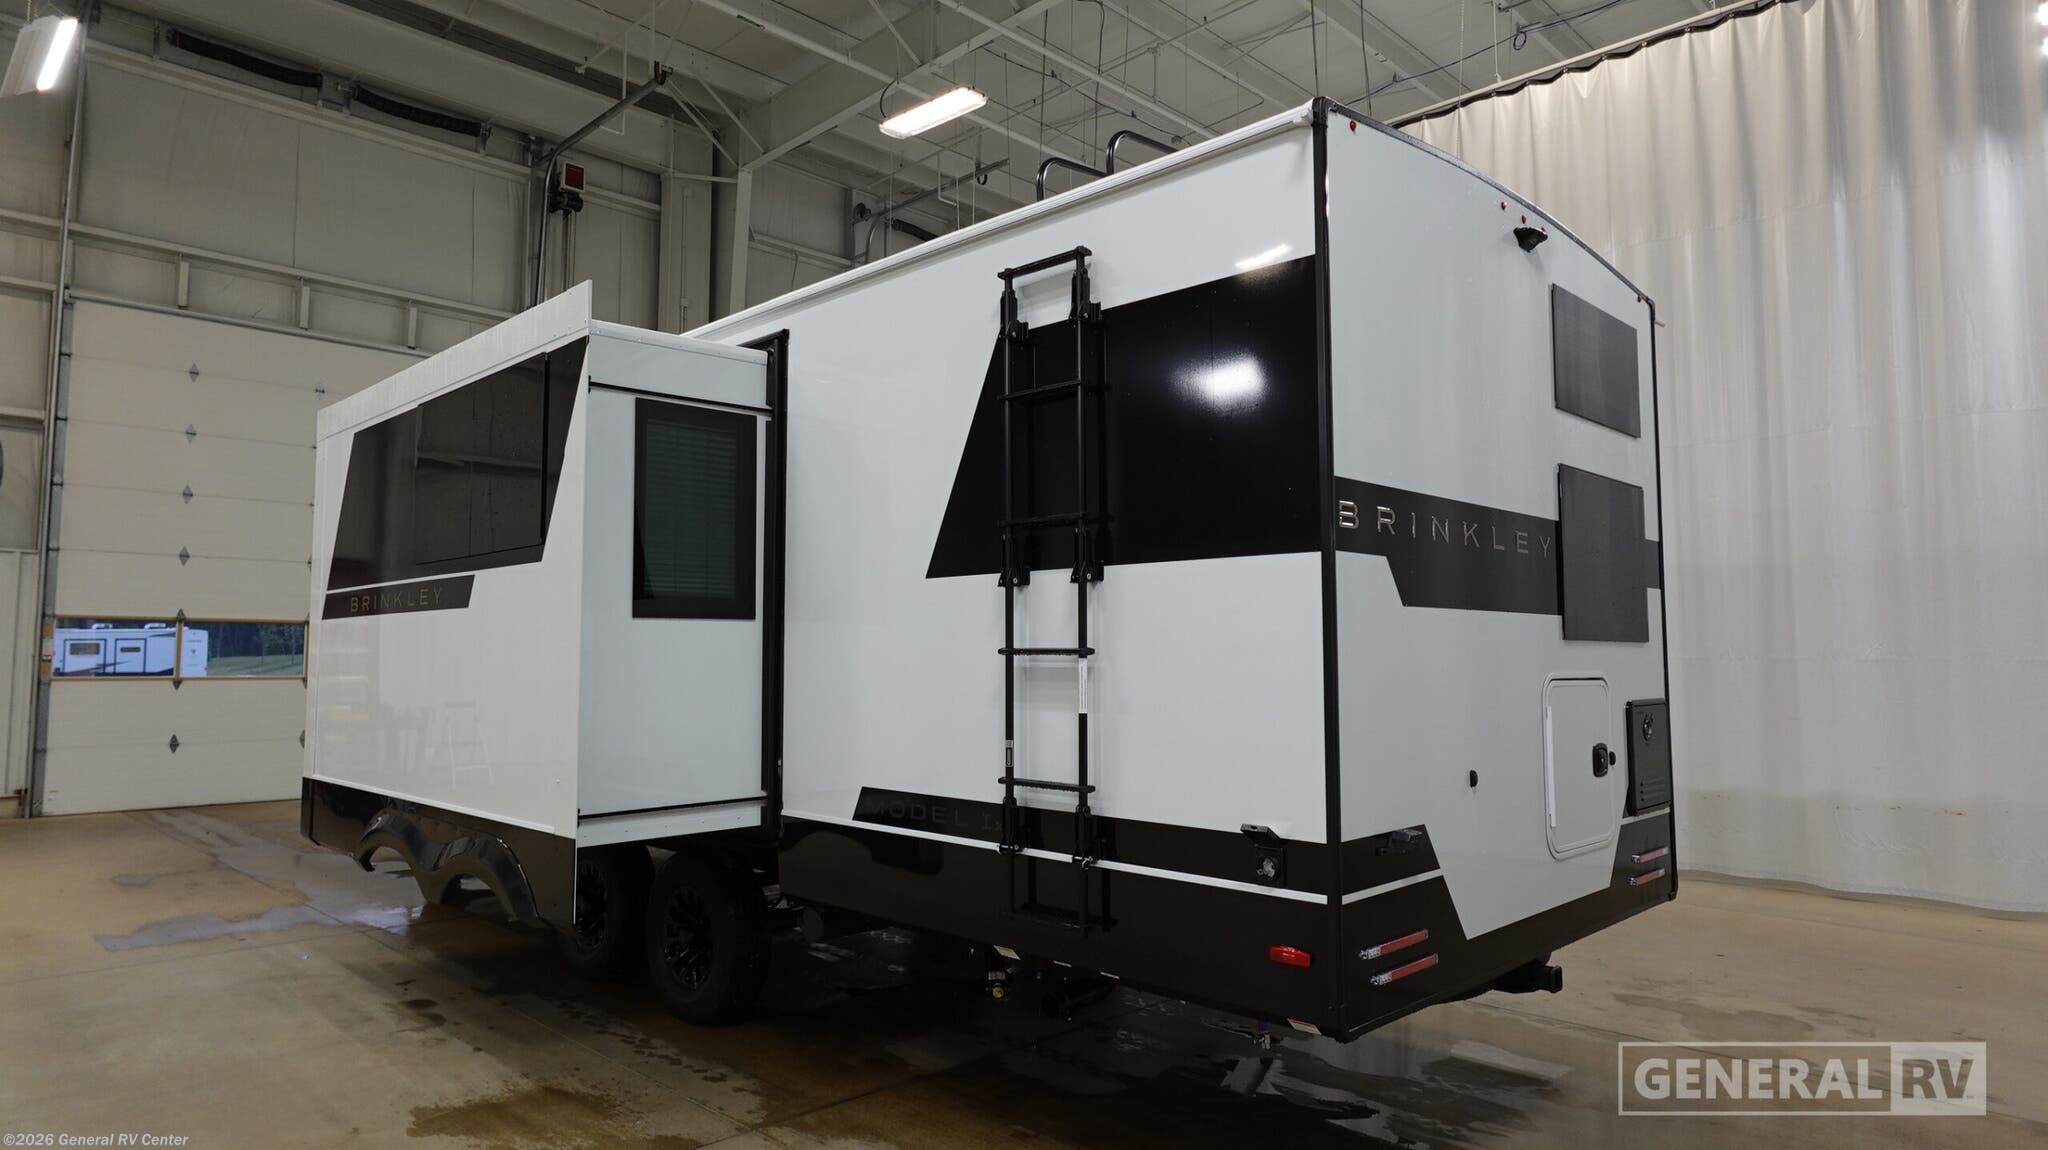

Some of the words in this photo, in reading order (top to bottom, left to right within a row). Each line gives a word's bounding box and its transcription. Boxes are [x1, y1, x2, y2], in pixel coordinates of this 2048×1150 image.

[1339, 500, 1551, 557] BRINKLEY
[351, 587, 443, 612] BRINKLEY
[865, 797, 968, 828] MODEL
